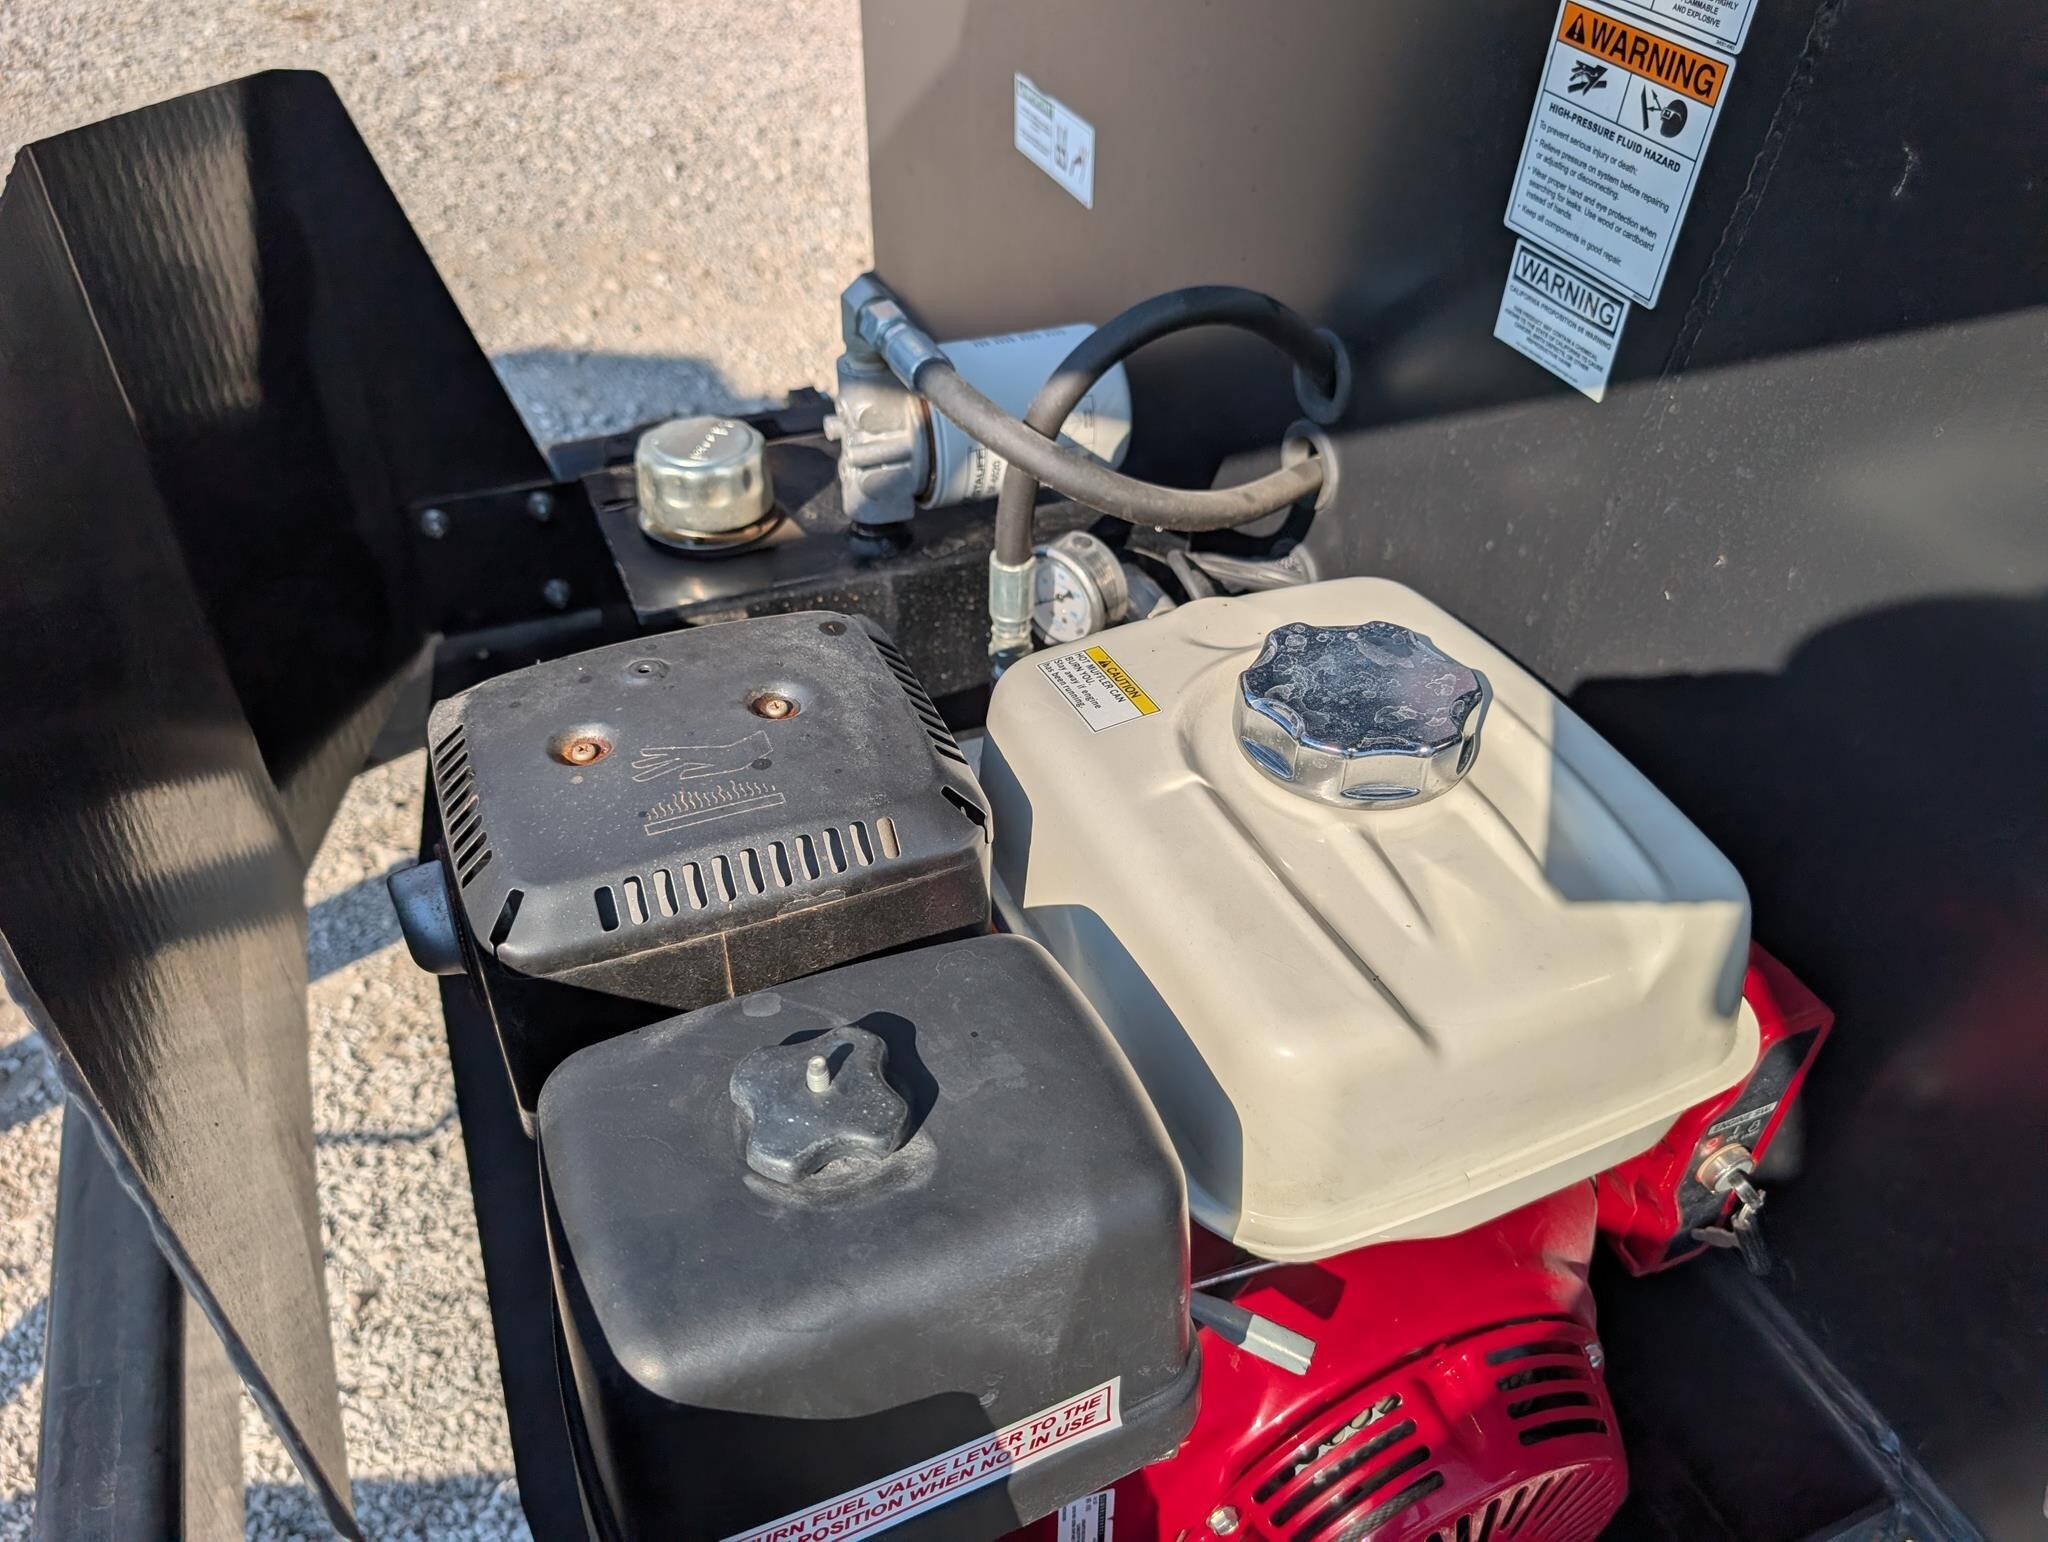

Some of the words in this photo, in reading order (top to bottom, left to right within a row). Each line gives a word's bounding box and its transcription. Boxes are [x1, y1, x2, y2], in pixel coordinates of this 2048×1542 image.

[1672, 3, 1686, 14] AND
[1687, 9, 1721, 28] EXPLOSIVE
[1591, 18, 1717, 98] WARNING
[1540, 120, 1547, 129] To
[1547, 123, 1570, 142] prevent
[1570, 136, 1592, 153] serious
[1592, 146, 1610, 164] injury
[1610, 156, 1618, 164] or
[1618, 159, 1638, 176] death:
[1548, 102, 1617, 142] HIGH-PRESSURE
[1616, 135, 1642, 154] FLUID
[1643, 147, 1681, 173] HAZARD
[1526, 190, 1547, 206] instead
[1547, 201, 1554, 210] of
[1531, 167, 1548, 180] Wear
[1547, 177, 1568, 191] proper
[1567, 184, 1583, 200] hand
[1583, 195, 1597, 206] and
[1596, 201, 1608, 213] eye
[1607, 208, 1639, 230] protection
[1639, 224, 1657, 239] when
[1535, 152, 1543, 160] or
[1543, 155, 1569, 176] adjusting
[1569, 168, 1577, 177] or
[1577, 170, 1619, 200] disconnecting.
[1539, 138, 1561, 157] Relieve
[1561, 151, 1588, 170] pressure
[1588, 164, 1597, 174] on
[1597, 168, 1620, 186] system
[1620, 179, 1641, 197] before
[1641, 191, 1670, 214] repairing
[1521, 205, 1537, 220] Keep
[1537, 212, 1545, 222] all
[1545, 218, 1580, 243] components
[1580, 236, 1586, 245] in
[1586, 239, 1603, 255] good
[1528, 179, 1556, 200] searching
[1556, 193, 1565, 203] for
[1584, 207, 1597, 220] Use
[1597, 216, 1615, 231] wood
[1614, 225, 1622, 233] or
[1622, 229, 1655, 253] cardboard
[1509, 284, 1540, 307] CALIFORNIA
[1540, 302, 1578, 331] PROPOSITION
[1585, 329, 1612, 351] WARNING
[1521, 255, 1615, 326] WARNING
[1042, 662, 1054, 673] has
[1051, 672, 1066, 686] been
[1063, 685, 1086, 709] running.
[1054, 659, 1066, 671] Stay
[1064, 671, 1080, 685] away
[1081, 689, 1102, 709] engine
[1065, 656, 1083, 673] BURN
[1074, 653, 1090, 664] HOT
[1087, 664, 1114, 690] MUFFLER
[1109, 688, 1127, 703] CAN
[1107, 667, 1140, 699] CAUTION
[797, 1494, 905, 1542] POSITION
[909, 1465, 975, 1500] WHEN
[979, 1445, 1022, 1473] NOT
[1028, 1432, 1050, 1450] IN
[1055, 1411, 1097, 1438] USE
[812, 1497, 871, 1528] FUEL
[876, 1465, 947, 1499] VALVE
[952, 1431, 1024, 1471] LEVER
[1029, 1416, 1056, 1436] TO
[1063, 1394, 1103, 1421] THE
